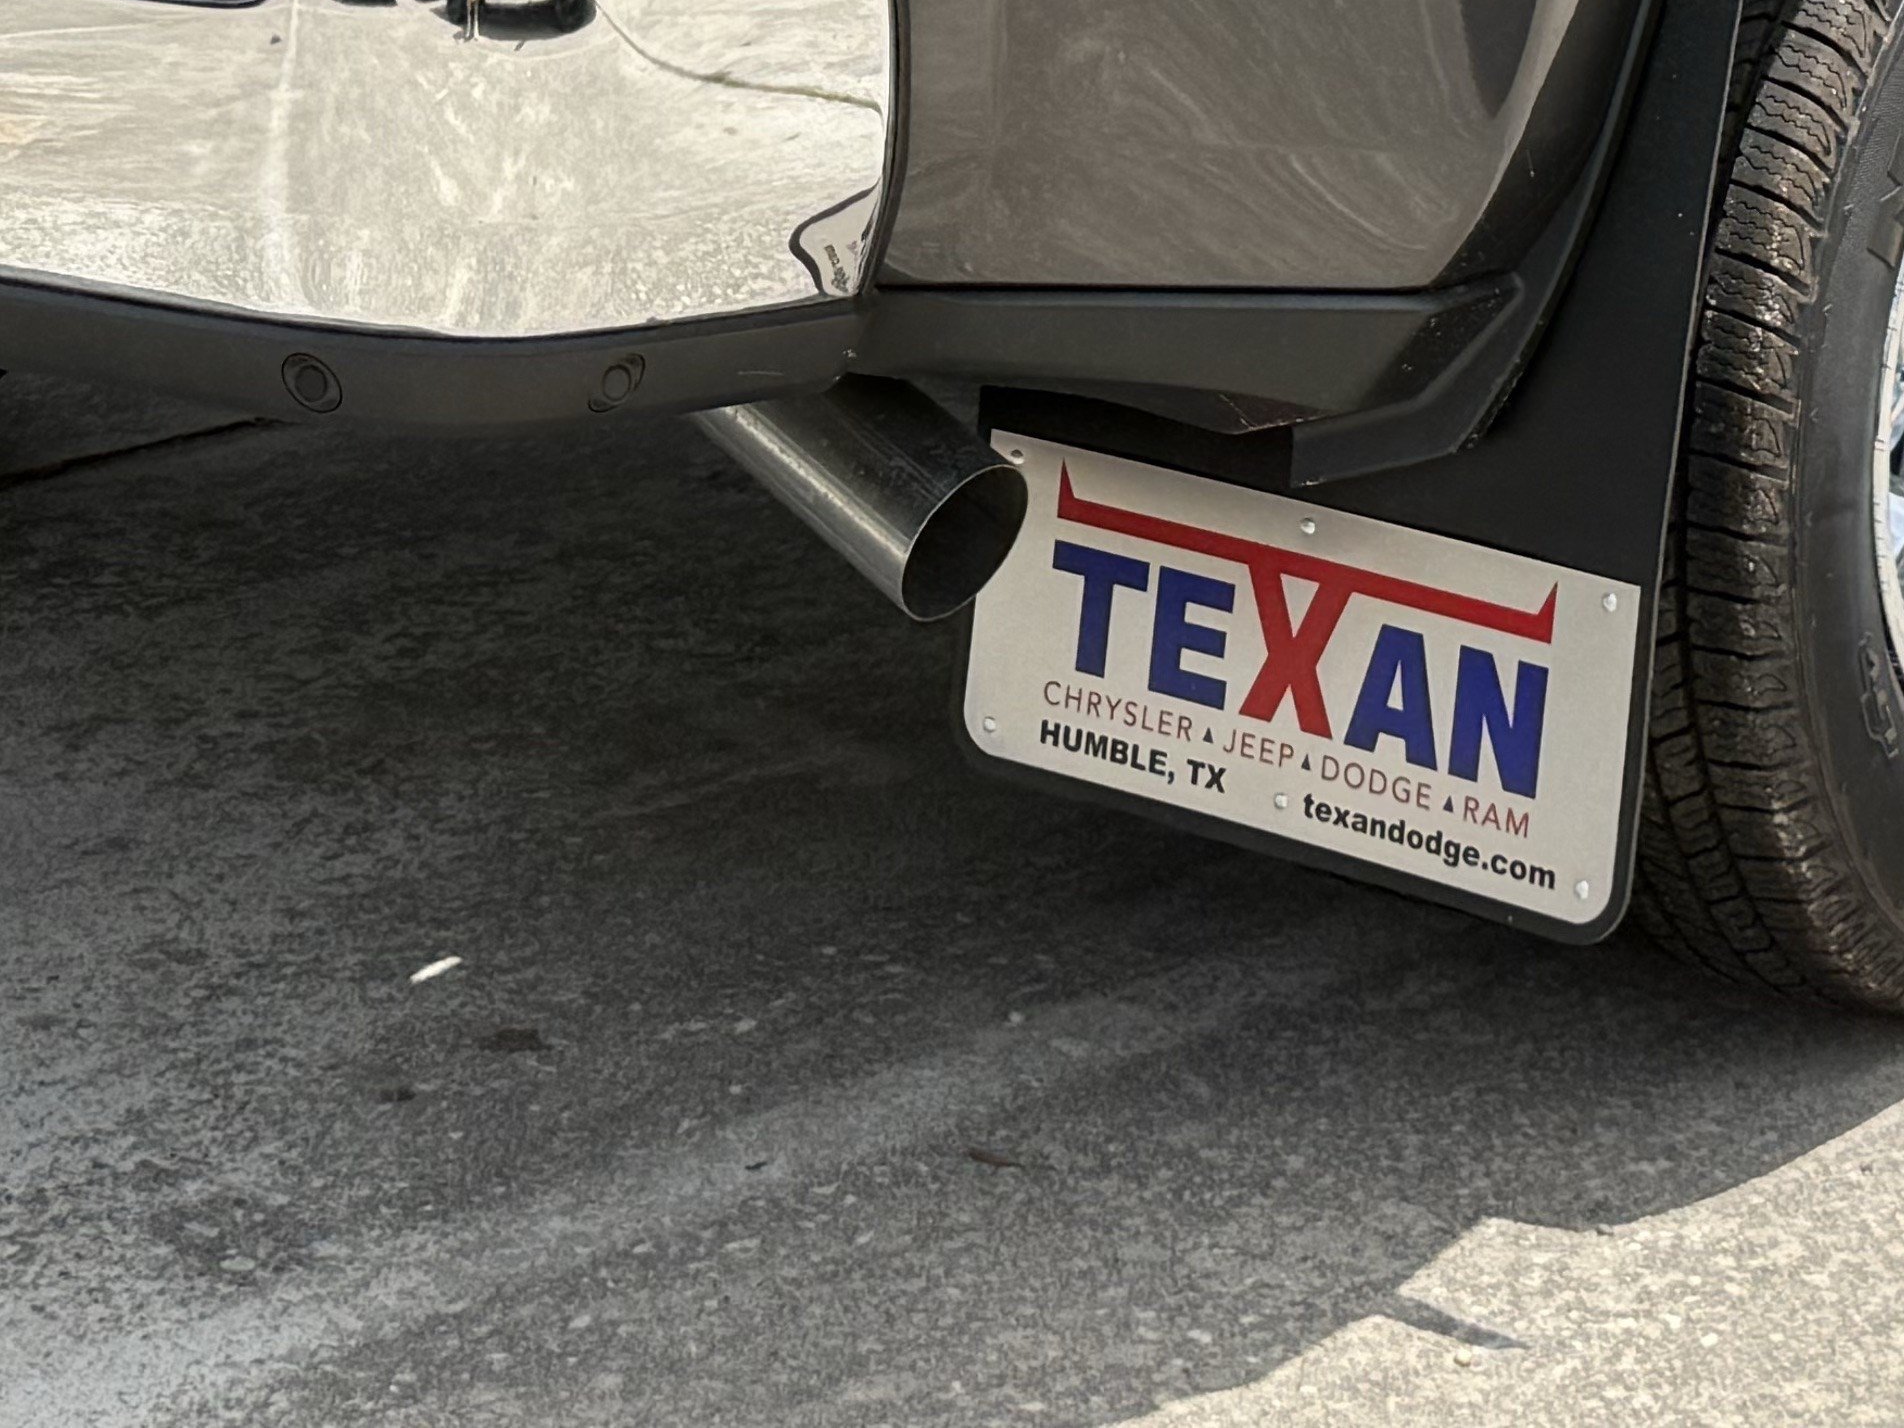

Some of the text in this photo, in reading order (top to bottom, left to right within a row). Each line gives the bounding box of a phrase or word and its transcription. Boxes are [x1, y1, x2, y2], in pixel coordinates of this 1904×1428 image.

[1052, 529, 1552, 800] TEXAN
[1039, 719, 1227, 794] HUMBLE, TX
[1043, 680, 1530, 839] CHRYSLER JEEP DODGE RAM
[1303, 792, 1557, 891] texandodge.com
